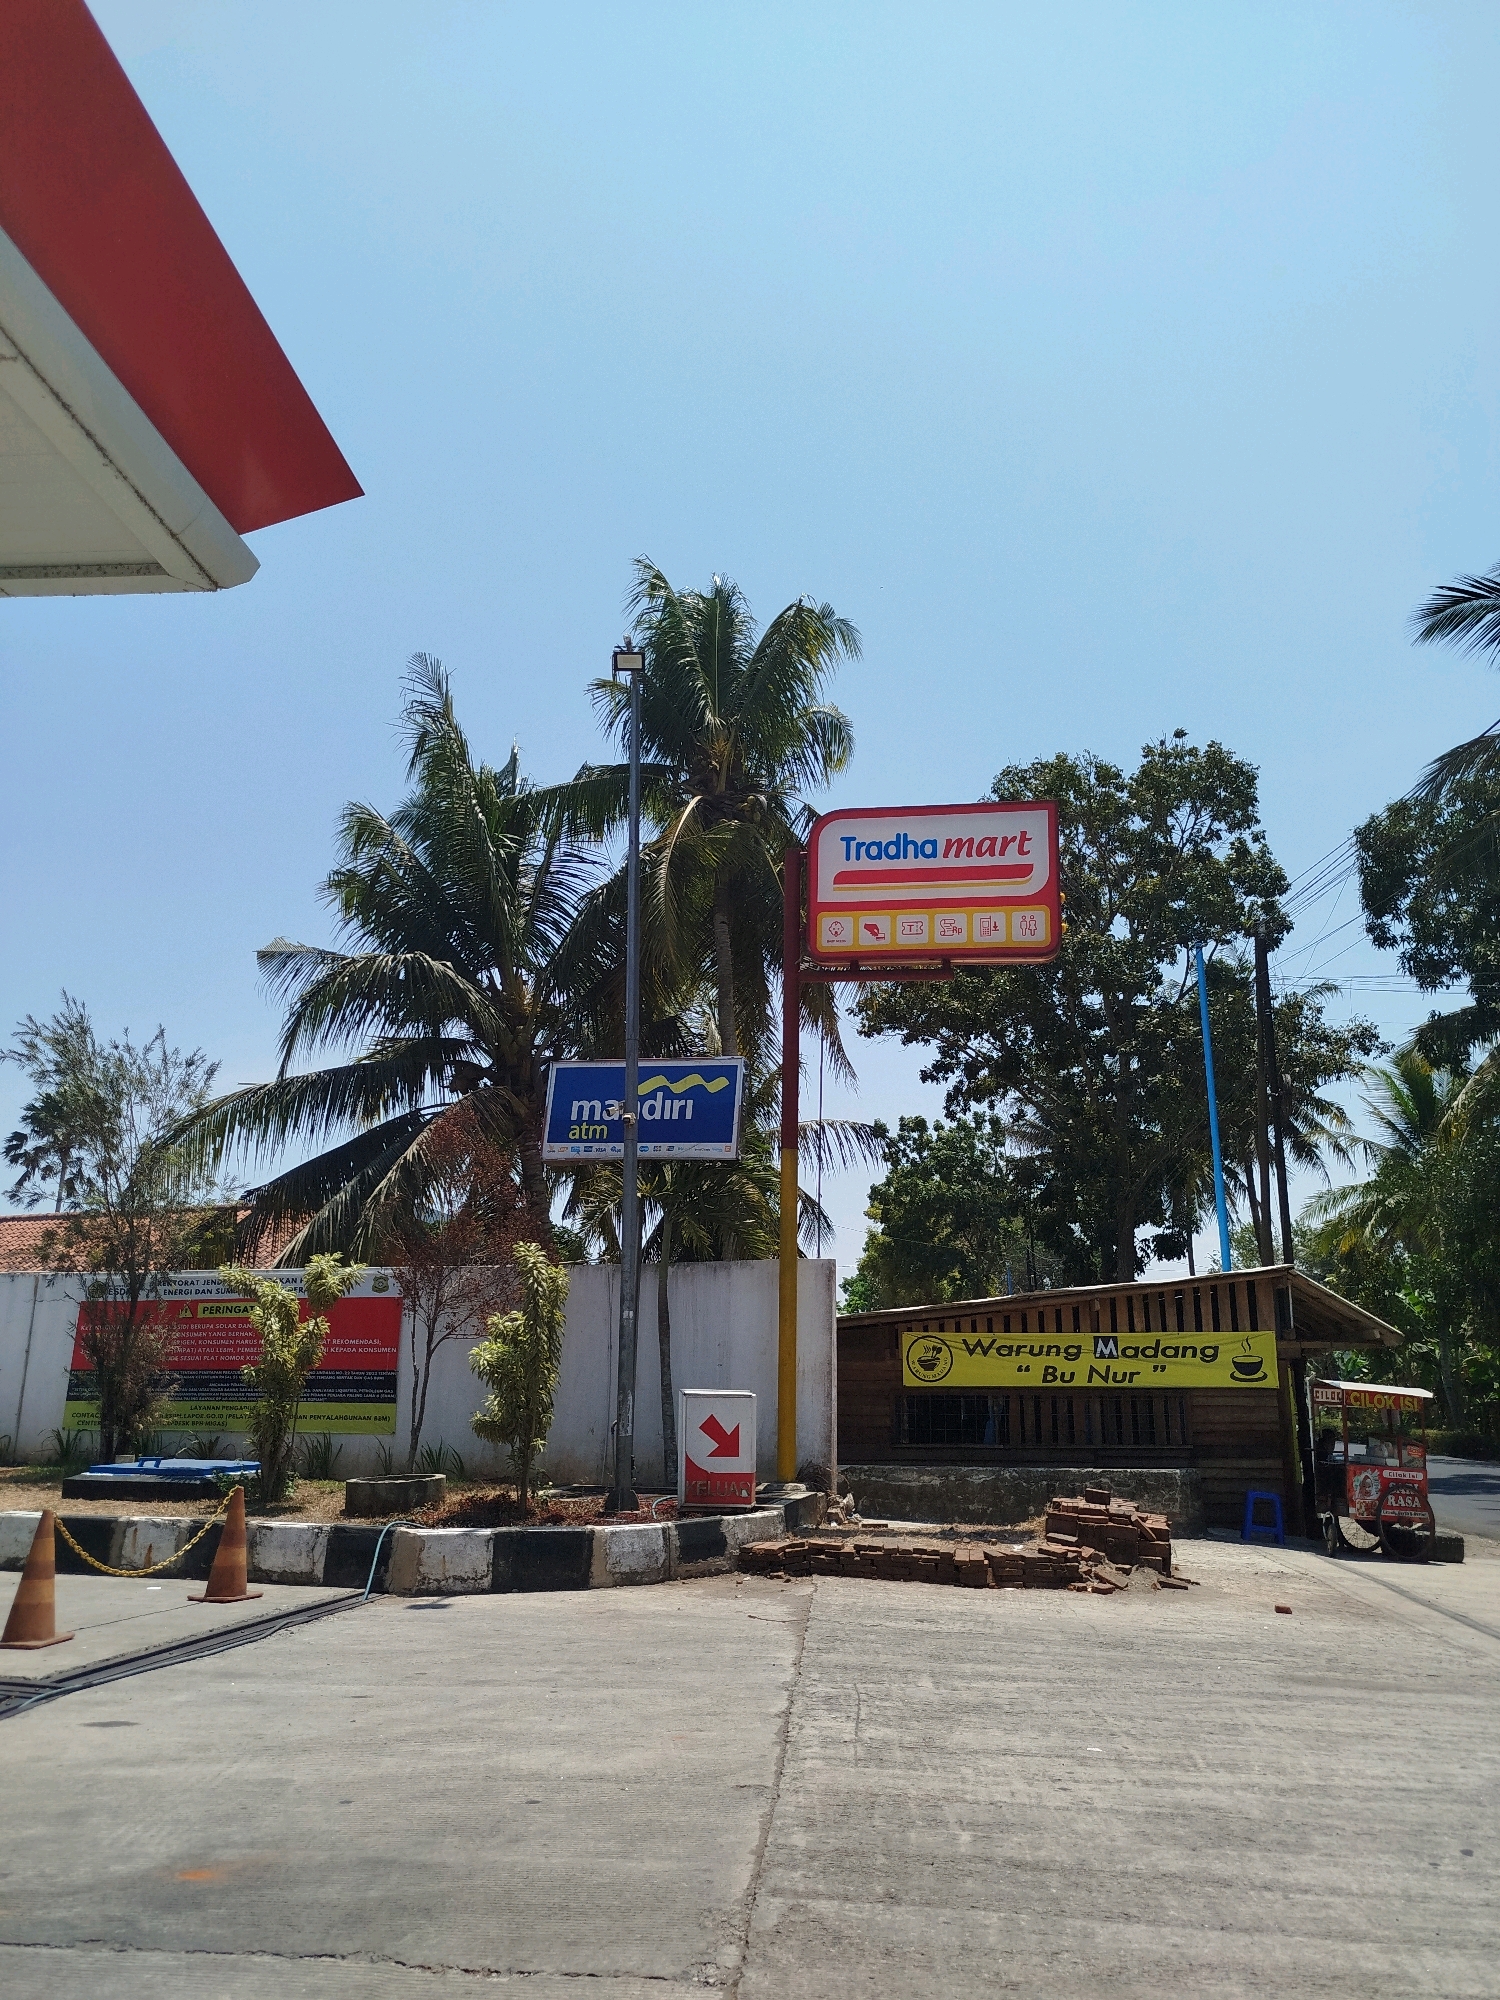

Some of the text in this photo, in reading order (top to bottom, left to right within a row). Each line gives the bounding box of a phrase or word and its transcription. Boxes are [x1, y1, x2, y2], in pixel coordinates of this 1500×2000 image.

[840, 830, 1033, 862] Tradha mart
[952, 926, 963, 935] Rp
[571, 1091, 694, 1121] madiri
[568, 1123, 608, 1140] atm
[163, 1288, 192, 1297] ENERGI
[961, 1337, 1220, 1363] Warung Madang
[1041, 1365, 1075, 1384] Bu
[1087, 1364, 1141, 1384] Nur
[1314, 1389, 1342, 1401] CILOK
[1350, 1391, 1418, 1412] CILOK ISI
[1387, 1494, 1421, 1508] RASA
